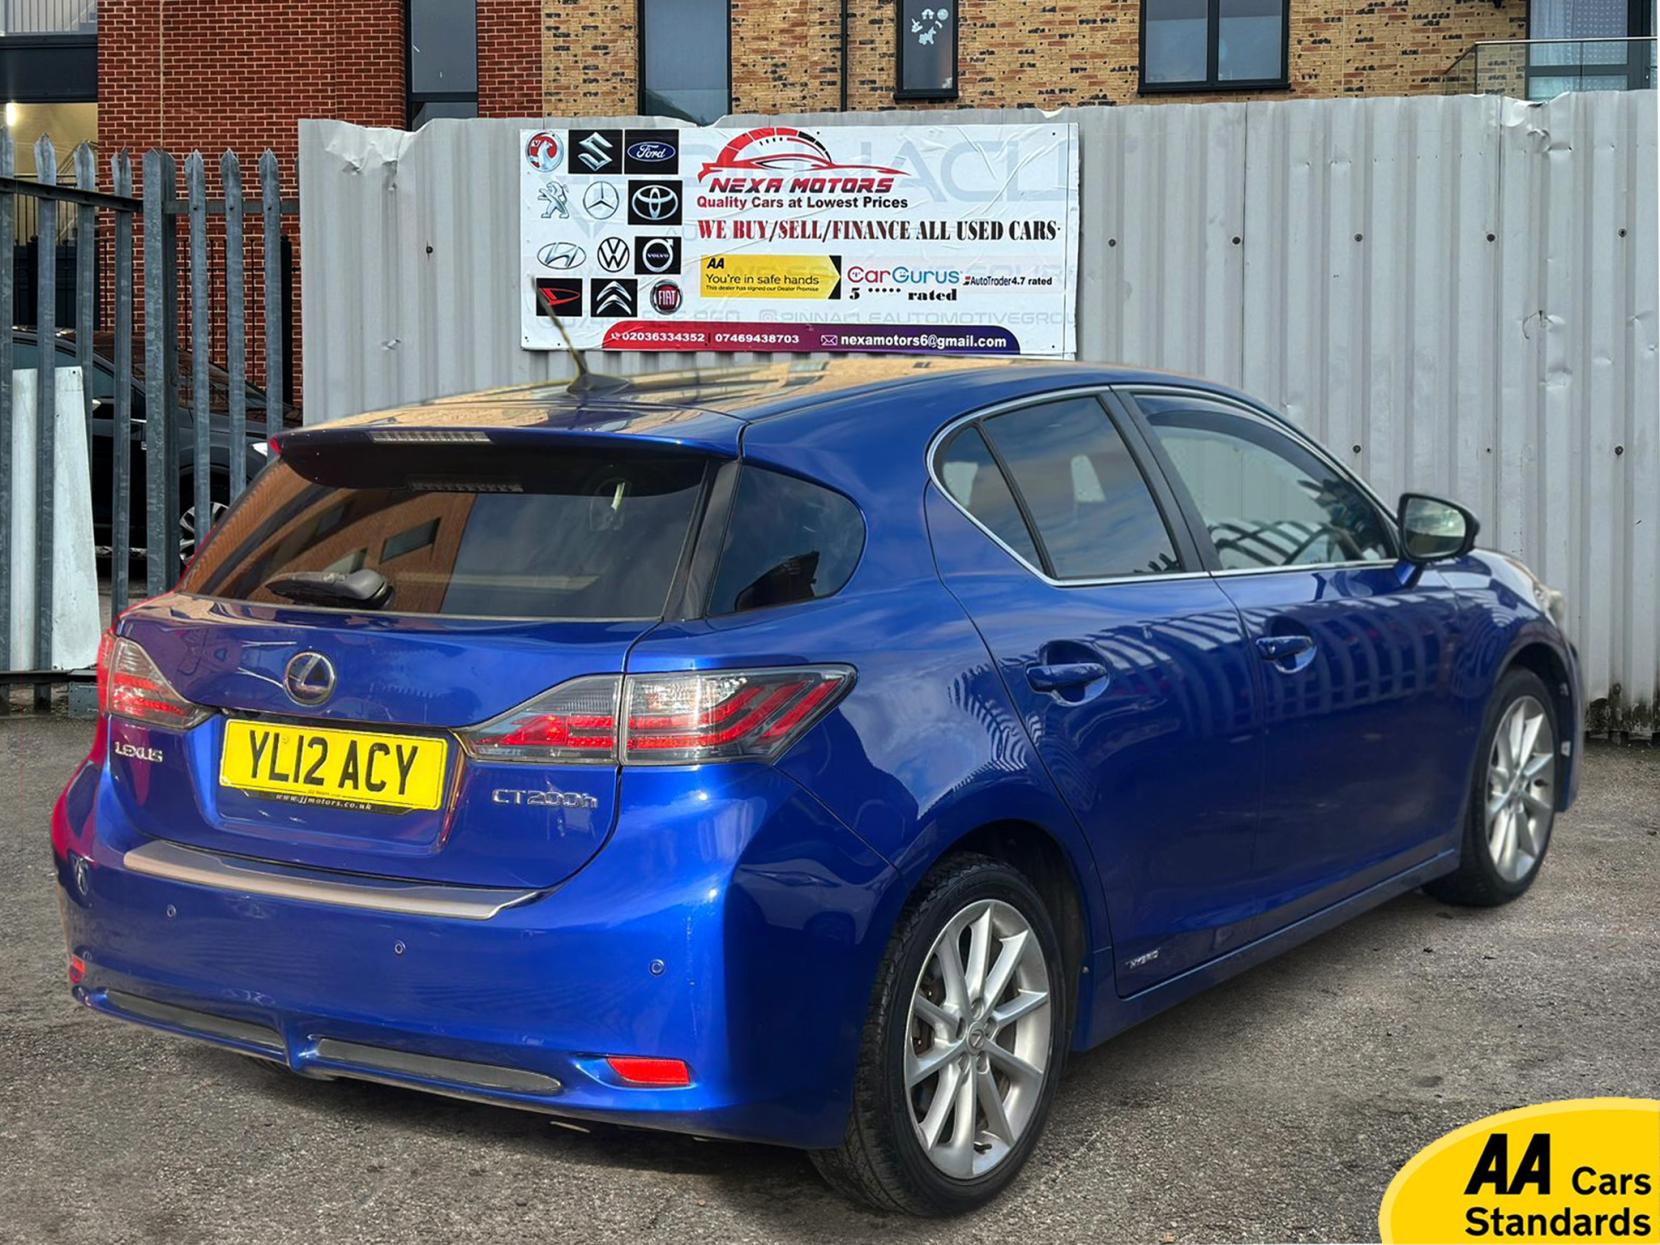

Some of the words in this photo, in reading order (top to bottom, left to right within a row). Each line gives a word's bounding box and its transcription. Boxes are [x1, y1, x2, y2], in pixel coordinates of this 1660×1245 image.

[636, 144, 666, 158] Ford
[709, 178, 784, 193] NEXA
[789, 178, 894, 193] MOTORS
[697, 197, 747, 210] Quality
[752, 197, 784, 208] Cars
[788, 197, 802, 208] at
[807, 197, 858, 208] Lowest
[863, 197, 908, 208] Prices
[697, 220, 726, 239] WE
[916, 221, 950, 240] ALL
[956, 221, 1003, 240] USED
[706, 258, 725, 269] AA
[706, 274, 741, 284] You're
[744, 275, 754, 284] in
[757, 274, 781, 284] safe
[784, 275, 819, 285] hands
[847, 266, 960, 284] CarGurus
[1028, 277, 1053, 286] rated
[658, 290, 676, 306] FIAT
[849, 288, 860, 300] 5
[908, 288, 957, 301] rated
[622, 333, 705, 342] 02036334352
[715, 335, 799, 344] 07469438703
[841, 334, 1007, 349] nexamotors6@gmail.com
[114, 741, 163, 763] LEXUS
[250, 730, 328, 786] YL12
[338, 740, 419, 796] ACY
[275, 794, 373, 811] www.jjmotors.co.uk
